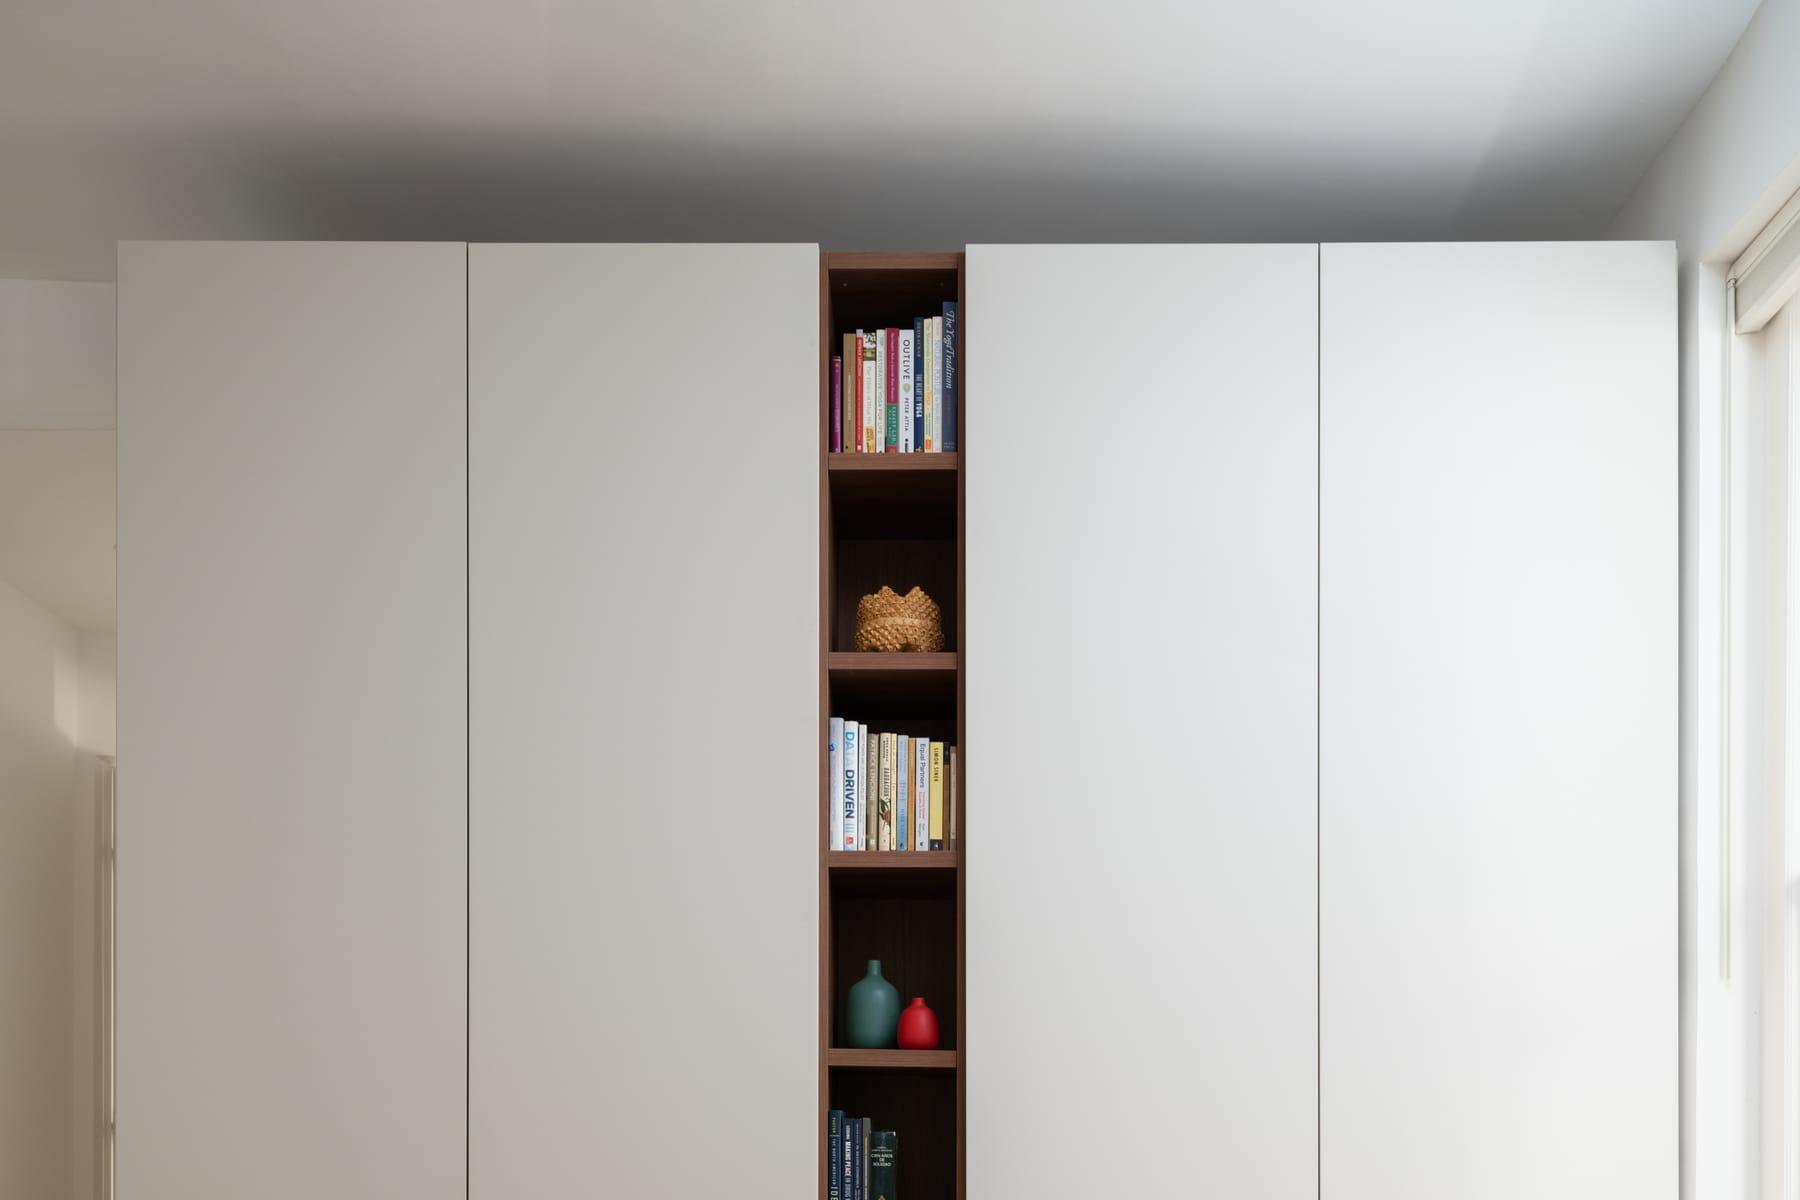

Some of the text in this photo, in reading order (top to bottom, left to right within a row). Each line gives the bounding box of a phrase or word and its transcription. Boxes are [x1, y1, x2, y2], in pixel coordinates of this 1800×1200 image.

[944, 329, 954, 350] Yoga
[945, 347, 954, 389] Tradition
[846, 770, 855, 819] DRIVEN
